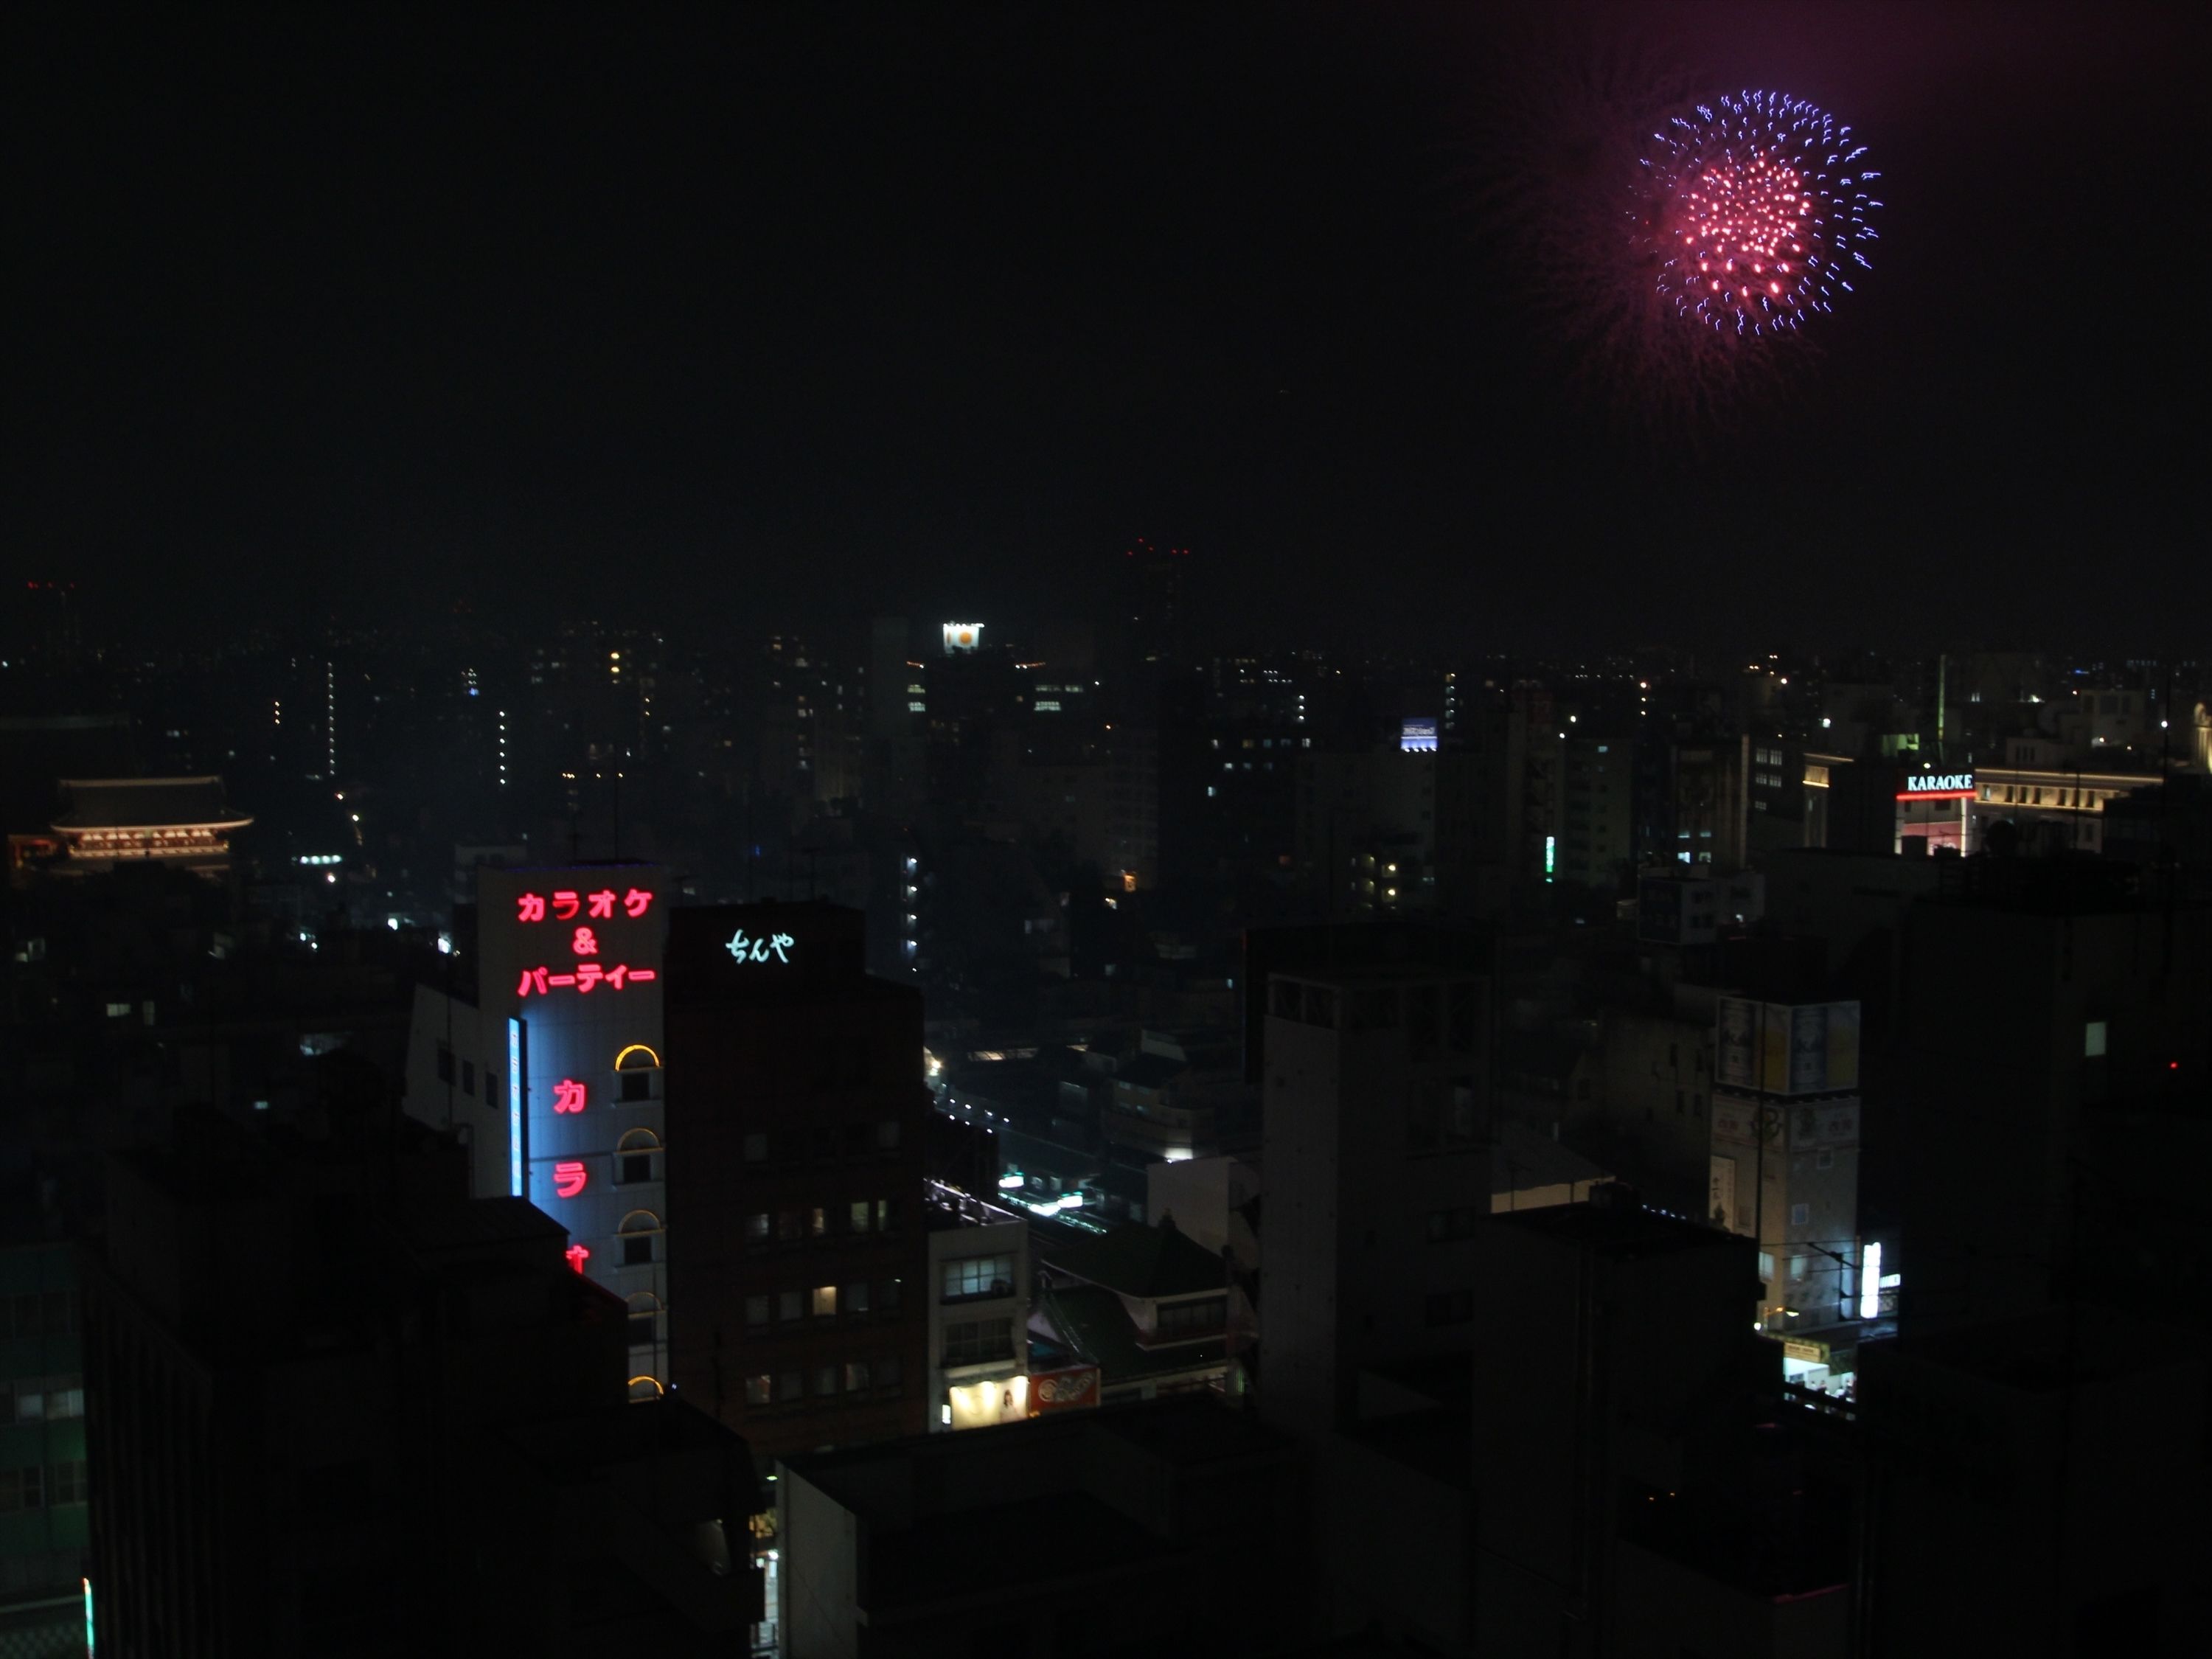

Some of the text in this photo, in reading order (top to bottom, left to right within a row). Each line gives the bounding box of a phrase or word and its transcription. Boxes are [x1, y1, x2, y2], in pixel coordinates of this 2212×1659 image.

[1907, 774, 1973, 791] KARAOKE
[518, 888, 653, 922] カラオケ
[572, 926, 598, 956] &
[725, 929, 794, 964] ちんや
[517, 963, 655, 997] パーティー
